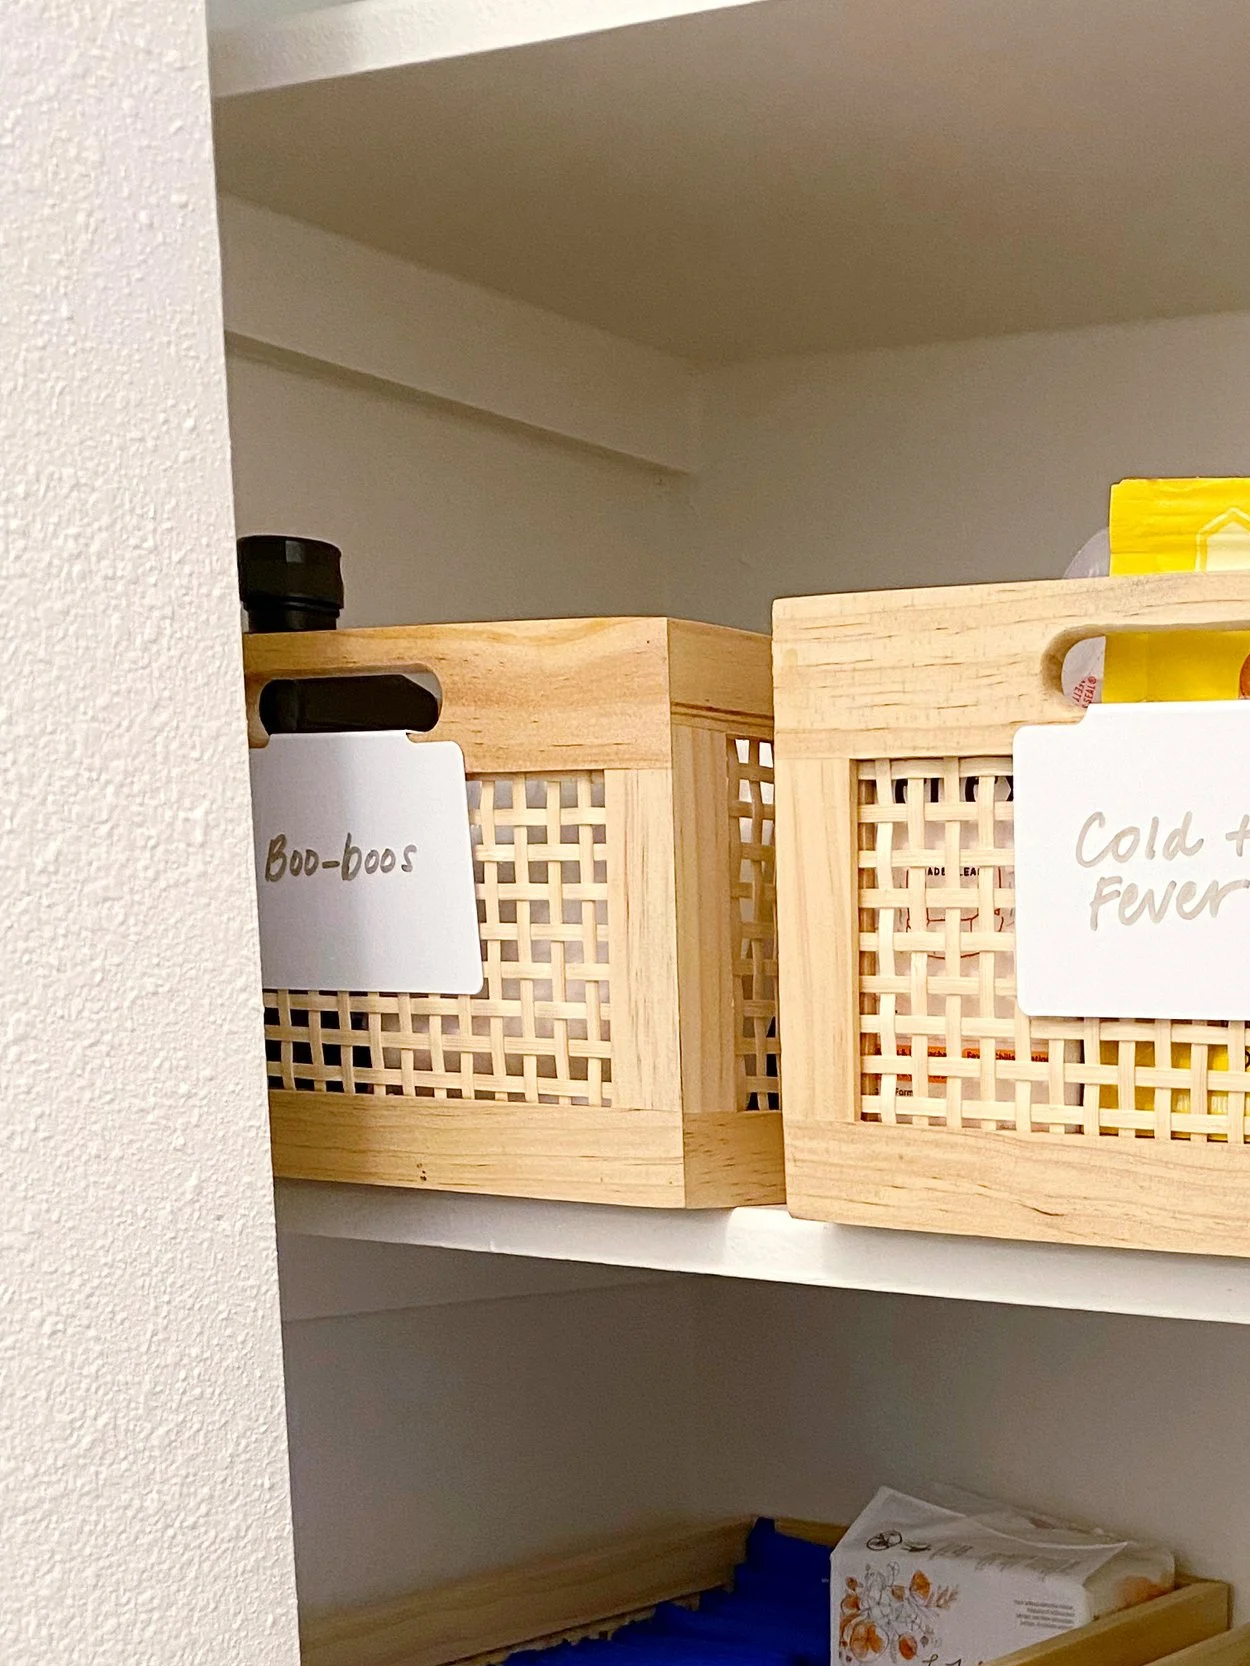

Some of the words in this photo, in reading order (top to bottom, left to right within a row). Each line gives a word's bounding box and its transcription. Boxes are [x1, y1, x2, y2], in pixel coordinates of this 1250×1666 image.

[264, 831, 418, 883] Boo-boos
[1075, 811, 1205, 869] Cold
[1089, 875, 1250, 932] Fever
